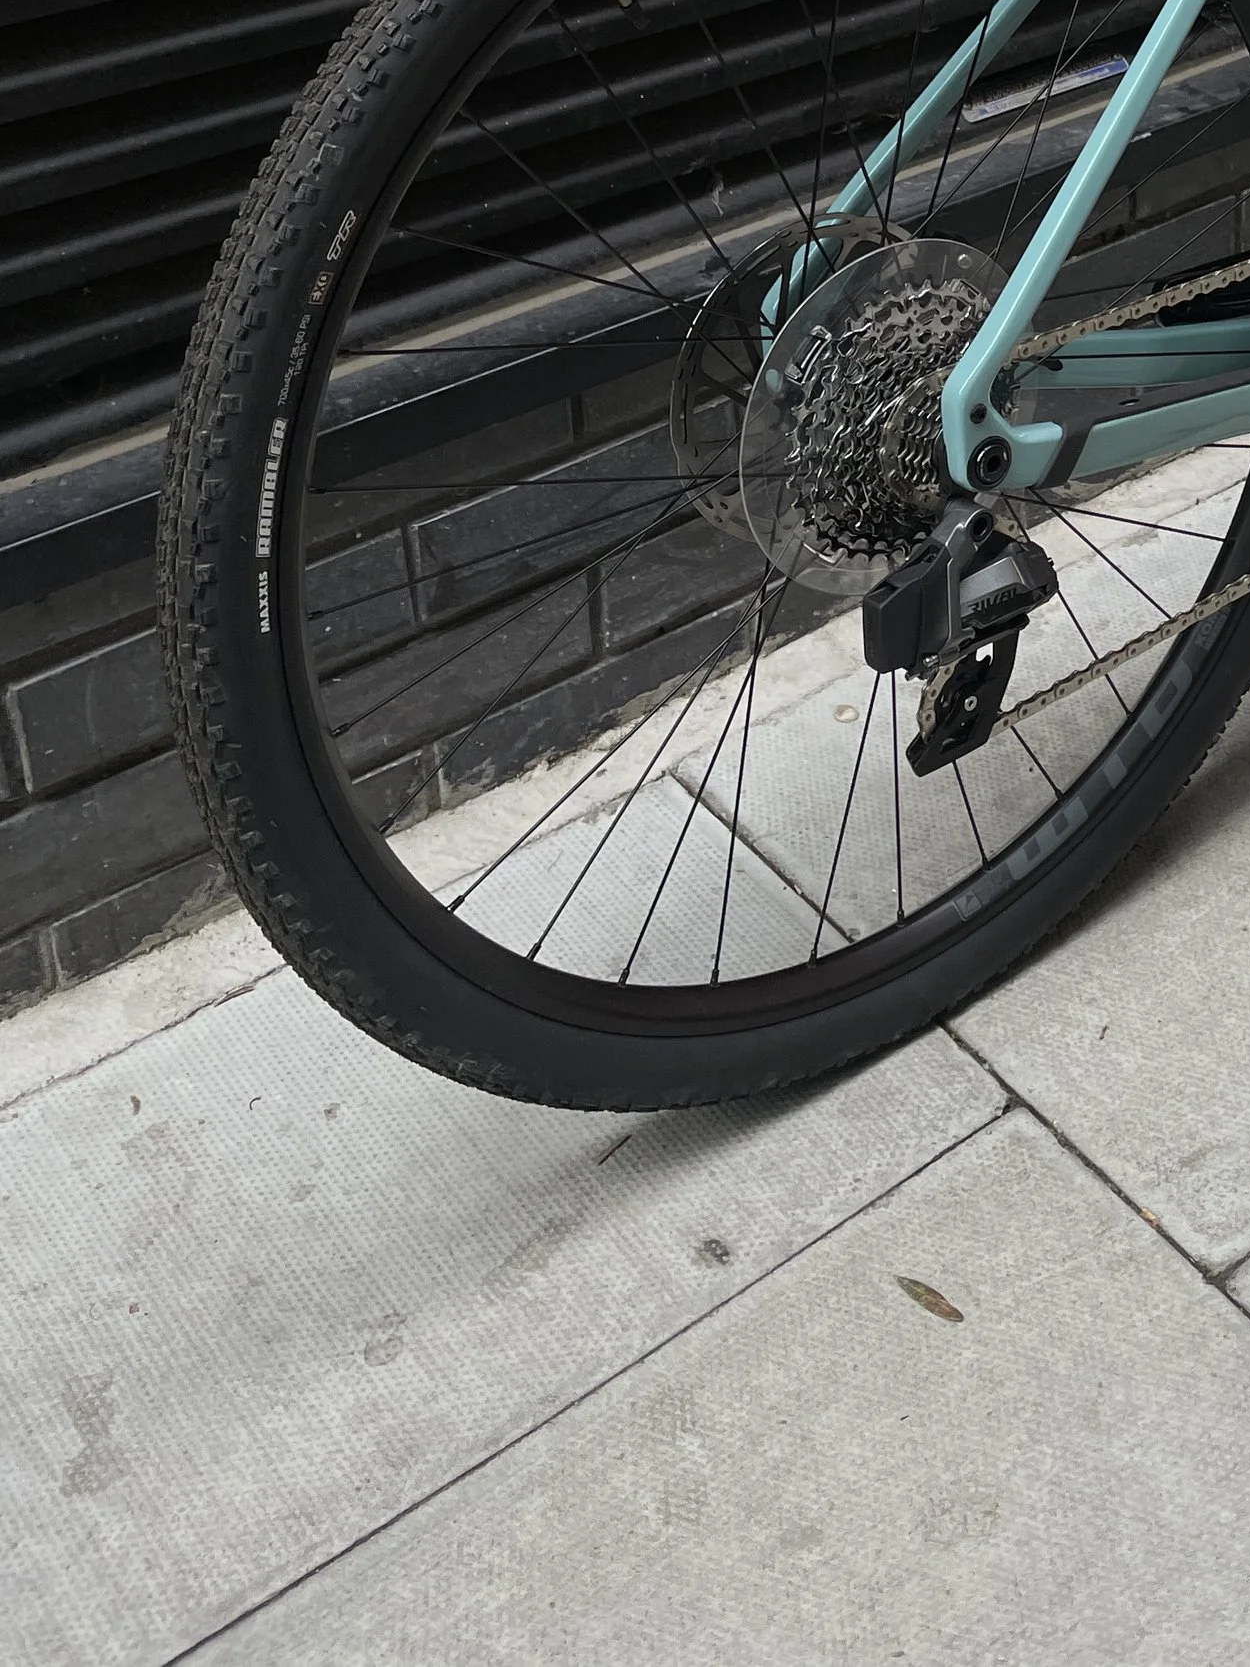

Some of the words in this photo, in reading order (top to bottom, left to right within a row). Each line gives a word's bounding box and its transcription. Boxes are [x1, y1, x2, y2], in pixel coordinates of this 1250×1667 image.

[255, 417, 288, 558] RAMBLER
[259, 571, 271, 634] MAXXIS
[969, 589, 1017, 615] RIVAL
